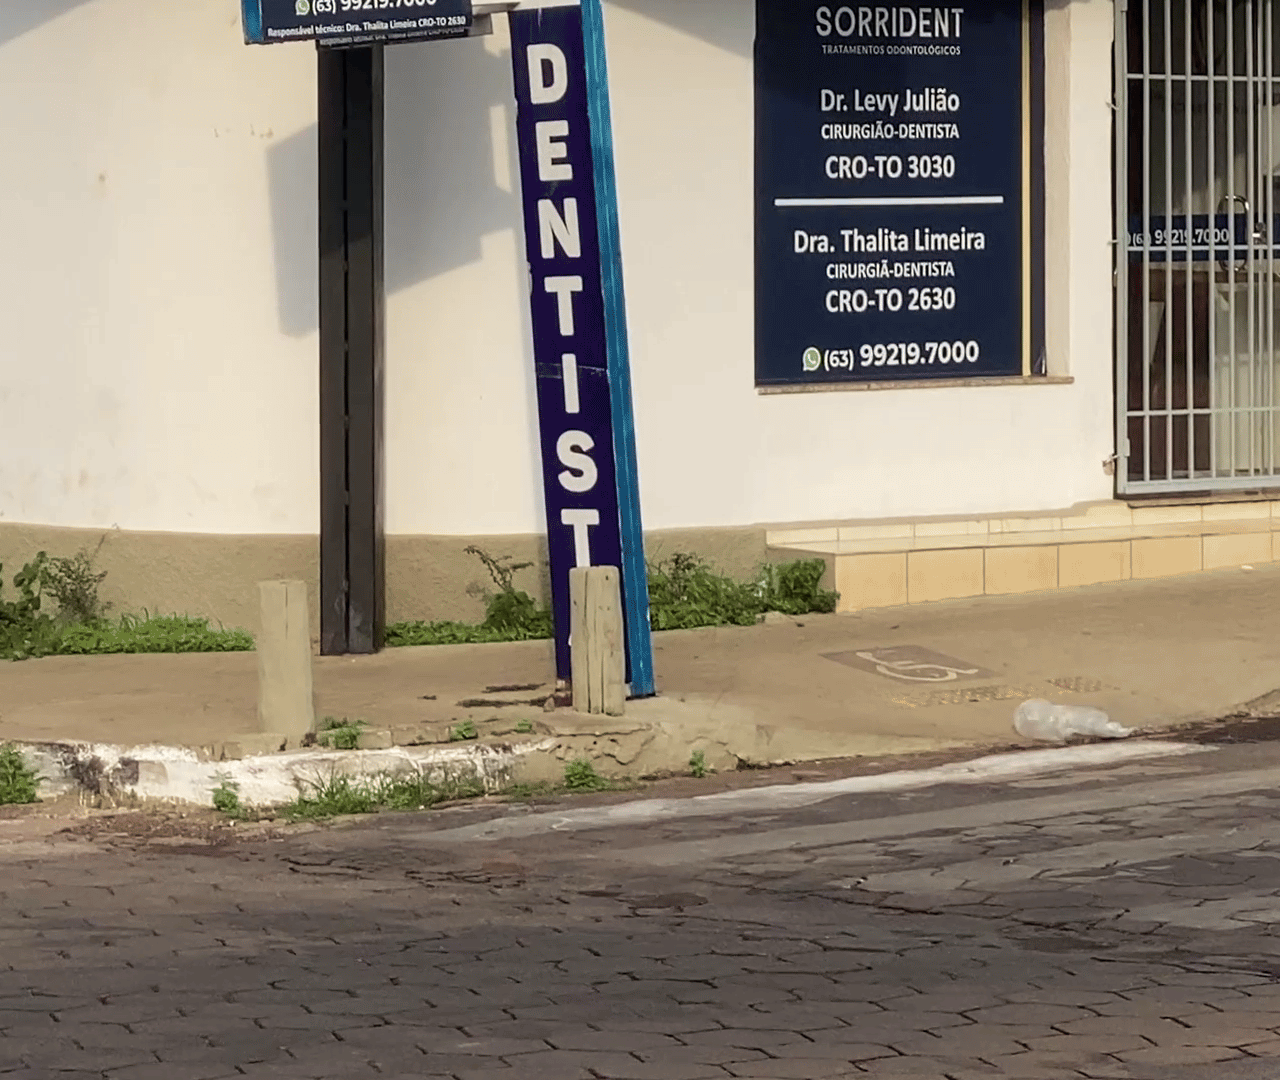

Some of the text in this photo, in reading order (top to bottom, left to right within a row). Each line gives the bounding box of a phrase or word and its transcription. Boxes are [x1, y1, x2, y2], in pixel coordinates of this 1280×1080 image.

[268, 25, 314, 38] Responsável
[316, 23, 345, 34] técnico:
[346, 22, 362, 32] Dra.
[363, 20, 388, 31] Thalita
[390, 19, 416, 29] Limeira
[418, 17, 446, 27] CRO-TO
[448, 16, 466, 25] 2630
[816, 6, 964, 38] SORRIDENT
[822, 44, 961, 55] TRATAMENTOS ODONTOLÓGICOS
[821, 87, 960, 117] Dr. Levy Julião
[821, 120, 959, 140] CIRURGIÃO-DENTISTA
[825, 155, 955, 179] CRO-TO 3030
[794, 227, 985, 254] Dra. Thalita Limeira
[1133, 232, 1151, 246] (6)
[826, 259, 954, 279] CIRURGIÃ-DENTISTA
[526, 42, 600, 570] DENTIST
[826, 287, 955, 313] CRO-TO 2630
[824, 341, 979, 371] (63) 99219.7000
